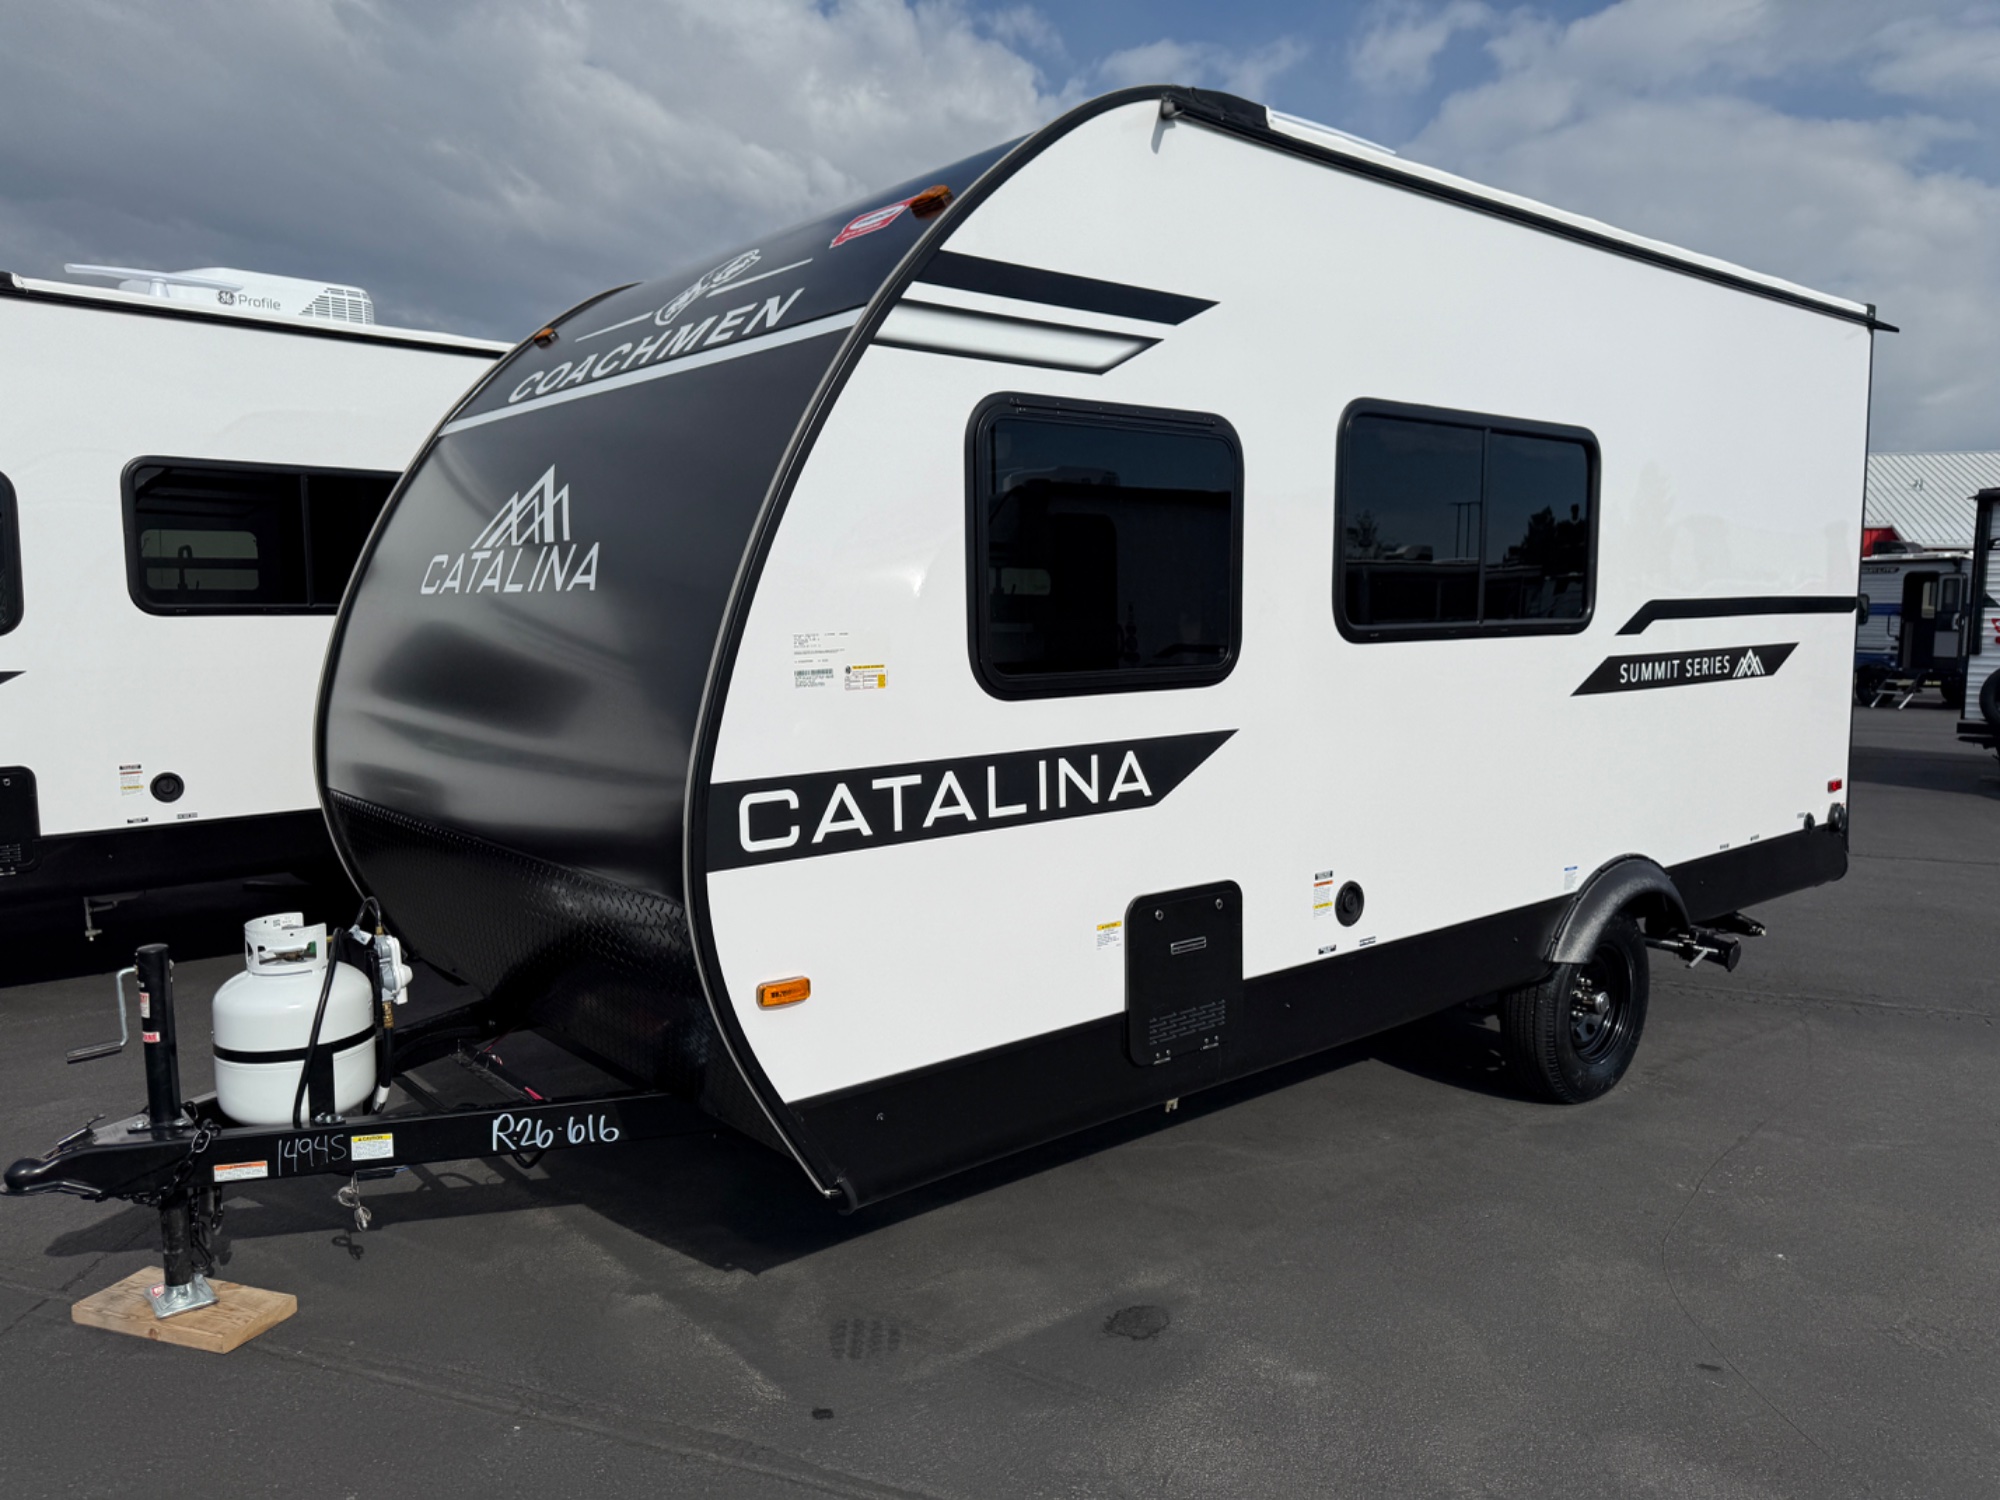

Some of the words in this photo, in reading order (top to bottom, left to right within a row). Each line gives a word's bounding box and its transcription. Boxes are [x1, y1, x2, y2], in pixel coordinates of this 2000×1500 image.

[238, 294, 281, 311] Profile
[508, 288, 805, 404] COACHMEN
[420, 542, 600, 595] CATALINA
[1619, 660, 1680, 684] SUMMIT
[1685, 655, 1731, 678] SERIES
[738, 749, 1153, 853] CATALINA
